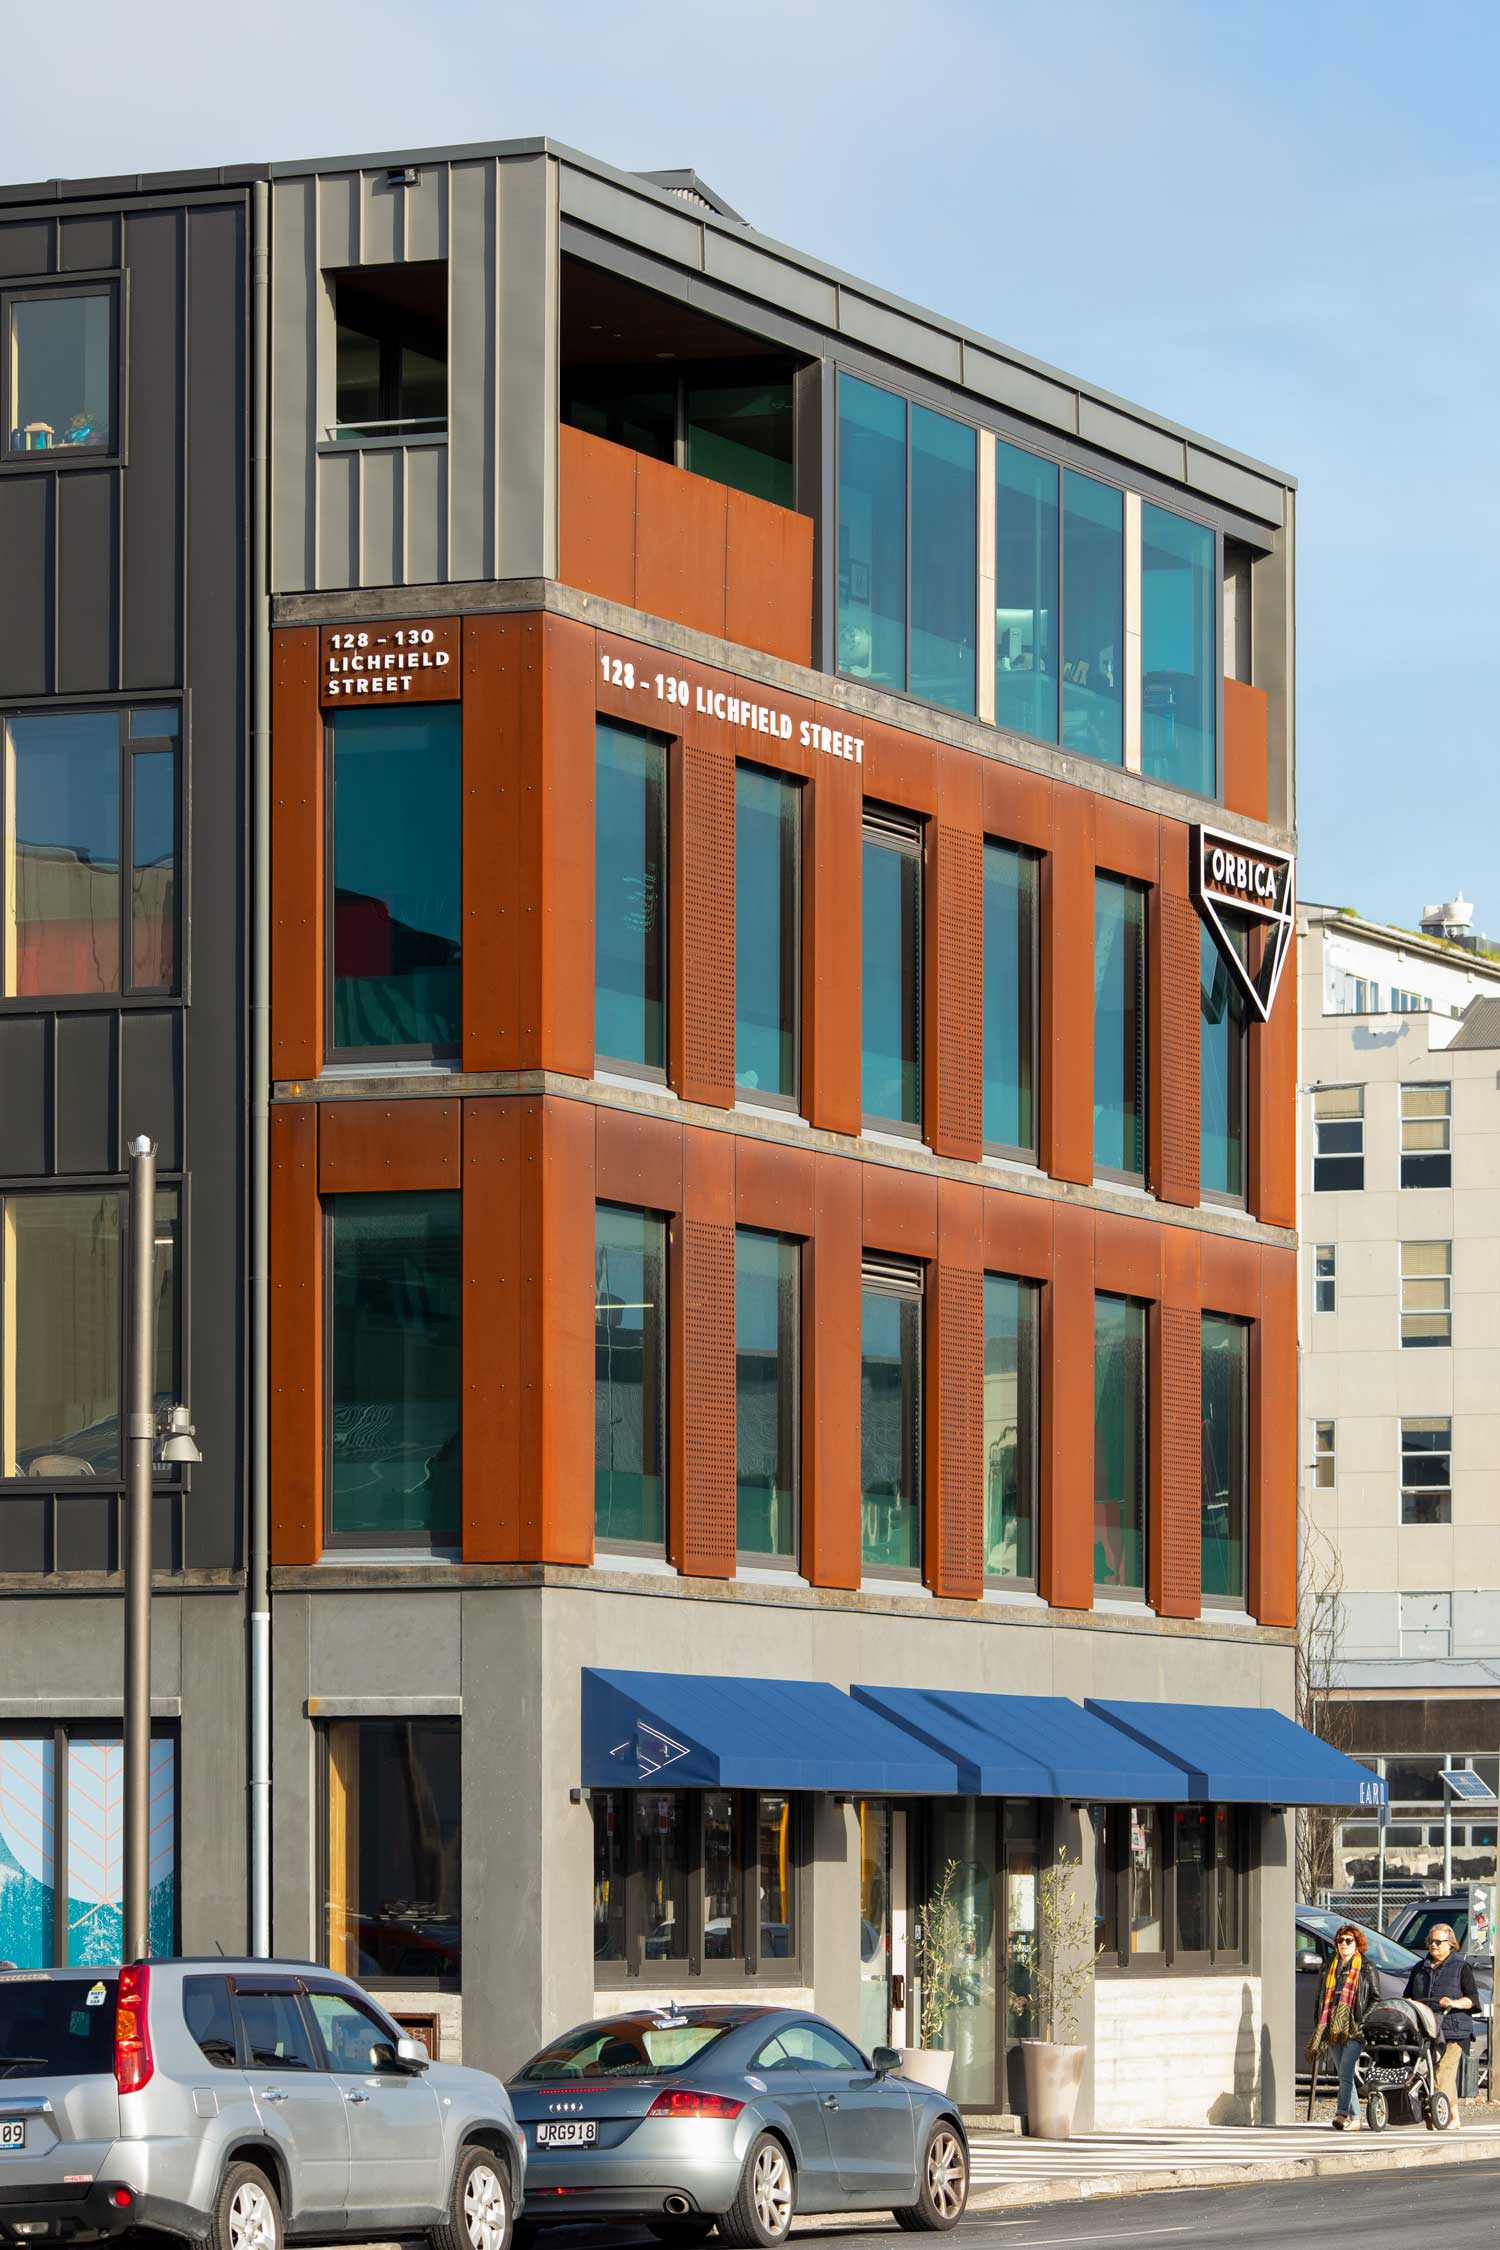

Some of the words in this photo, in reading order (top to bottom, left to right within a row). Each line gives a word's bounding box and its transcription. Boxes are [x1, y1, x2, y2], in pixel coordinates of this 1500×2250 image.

[331, 633, 369, 649] 128
[394, 629, 434, 645] 130
[329, 651, 450, 673] LICHFIELD
[328, 675, 413, 695] STREET
[601, 655, 635, 690] 128
[655, 674, 690, 707] 130
[696, 686, 793, 740] LICHFIELD
[800, 720, 865, 764] STREET
[1212, 848, 1277, 900] ORBICA
[1359, 1782, 1386, 1805] EARL
[539, 2122, 595, 2141] JRG918
